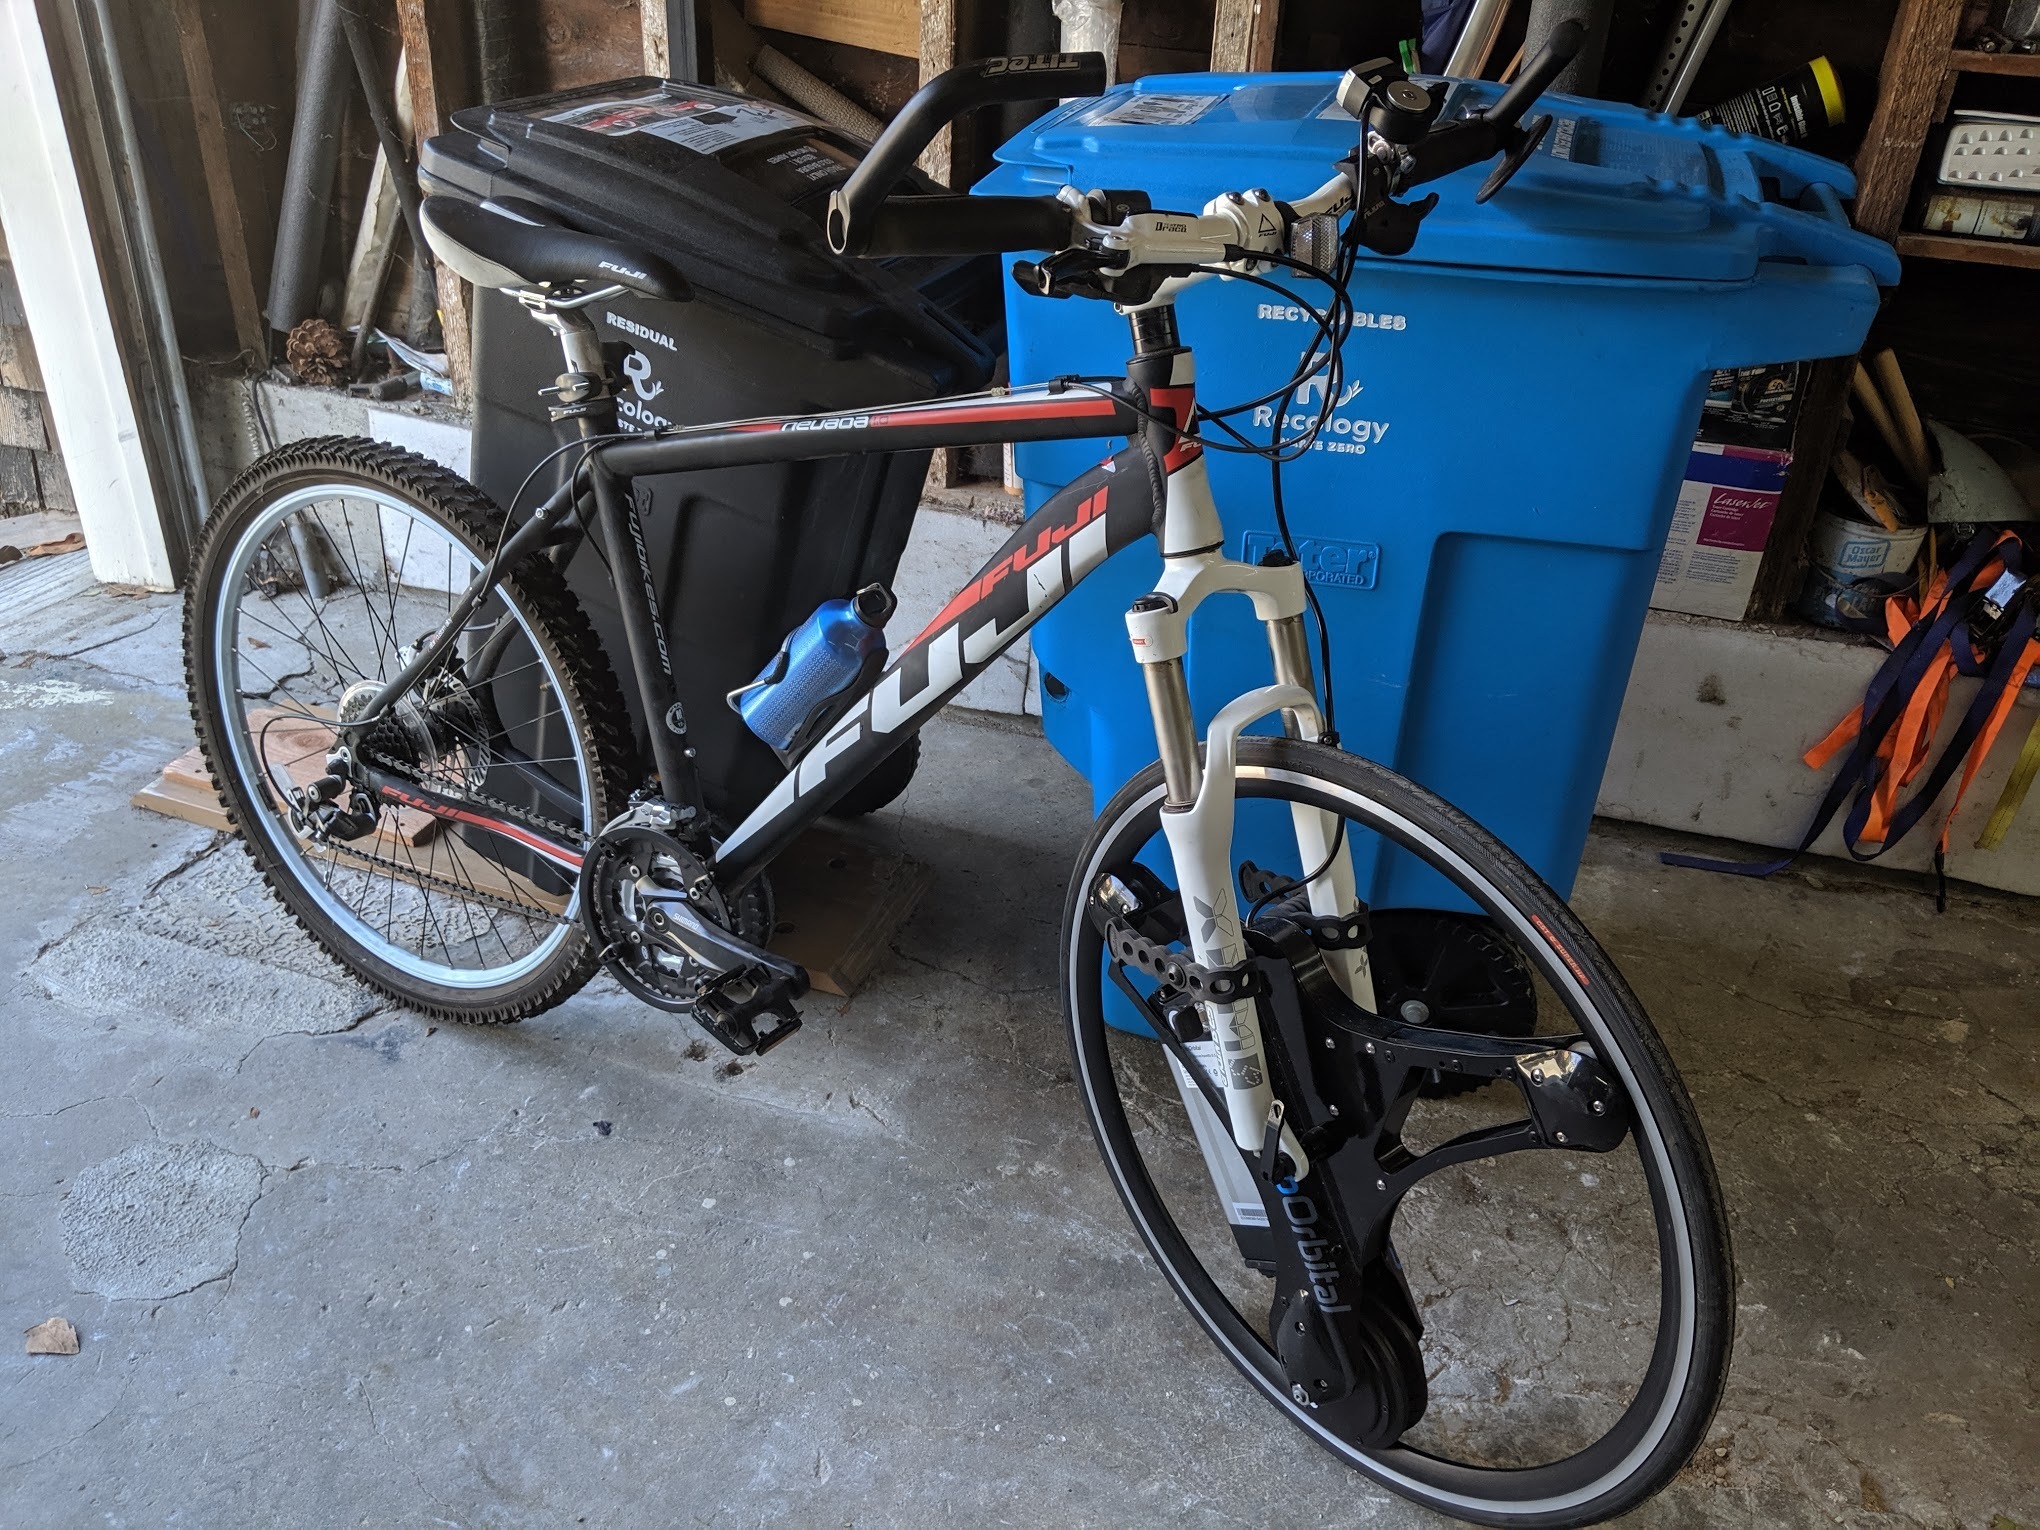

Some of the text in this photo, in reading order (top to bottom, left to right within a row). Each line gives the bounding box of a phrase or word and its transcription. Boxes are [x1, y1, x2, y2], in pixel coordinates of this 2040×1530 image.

[598, 261, 648, 280] FUJI
[606, 311, 678, 352] RESIDUAL
[1253, 405, 1390, 444] Recology
[1327, 441, 1366, 455] ZERO
[1714, 493, 1770, 509] LaserJet
[981, 486, 1109, 600] FUJI
[1247, 535, 1370, 575] Tter
[1851, 545, 1882, 555] Oscar
[1847, 554, 1882, 567] Mayer
[798, 514, 1109, 798] FUJI
[382, 786, 460, 818] FUJI
[673, 913, 700, 930] SHIMANO
